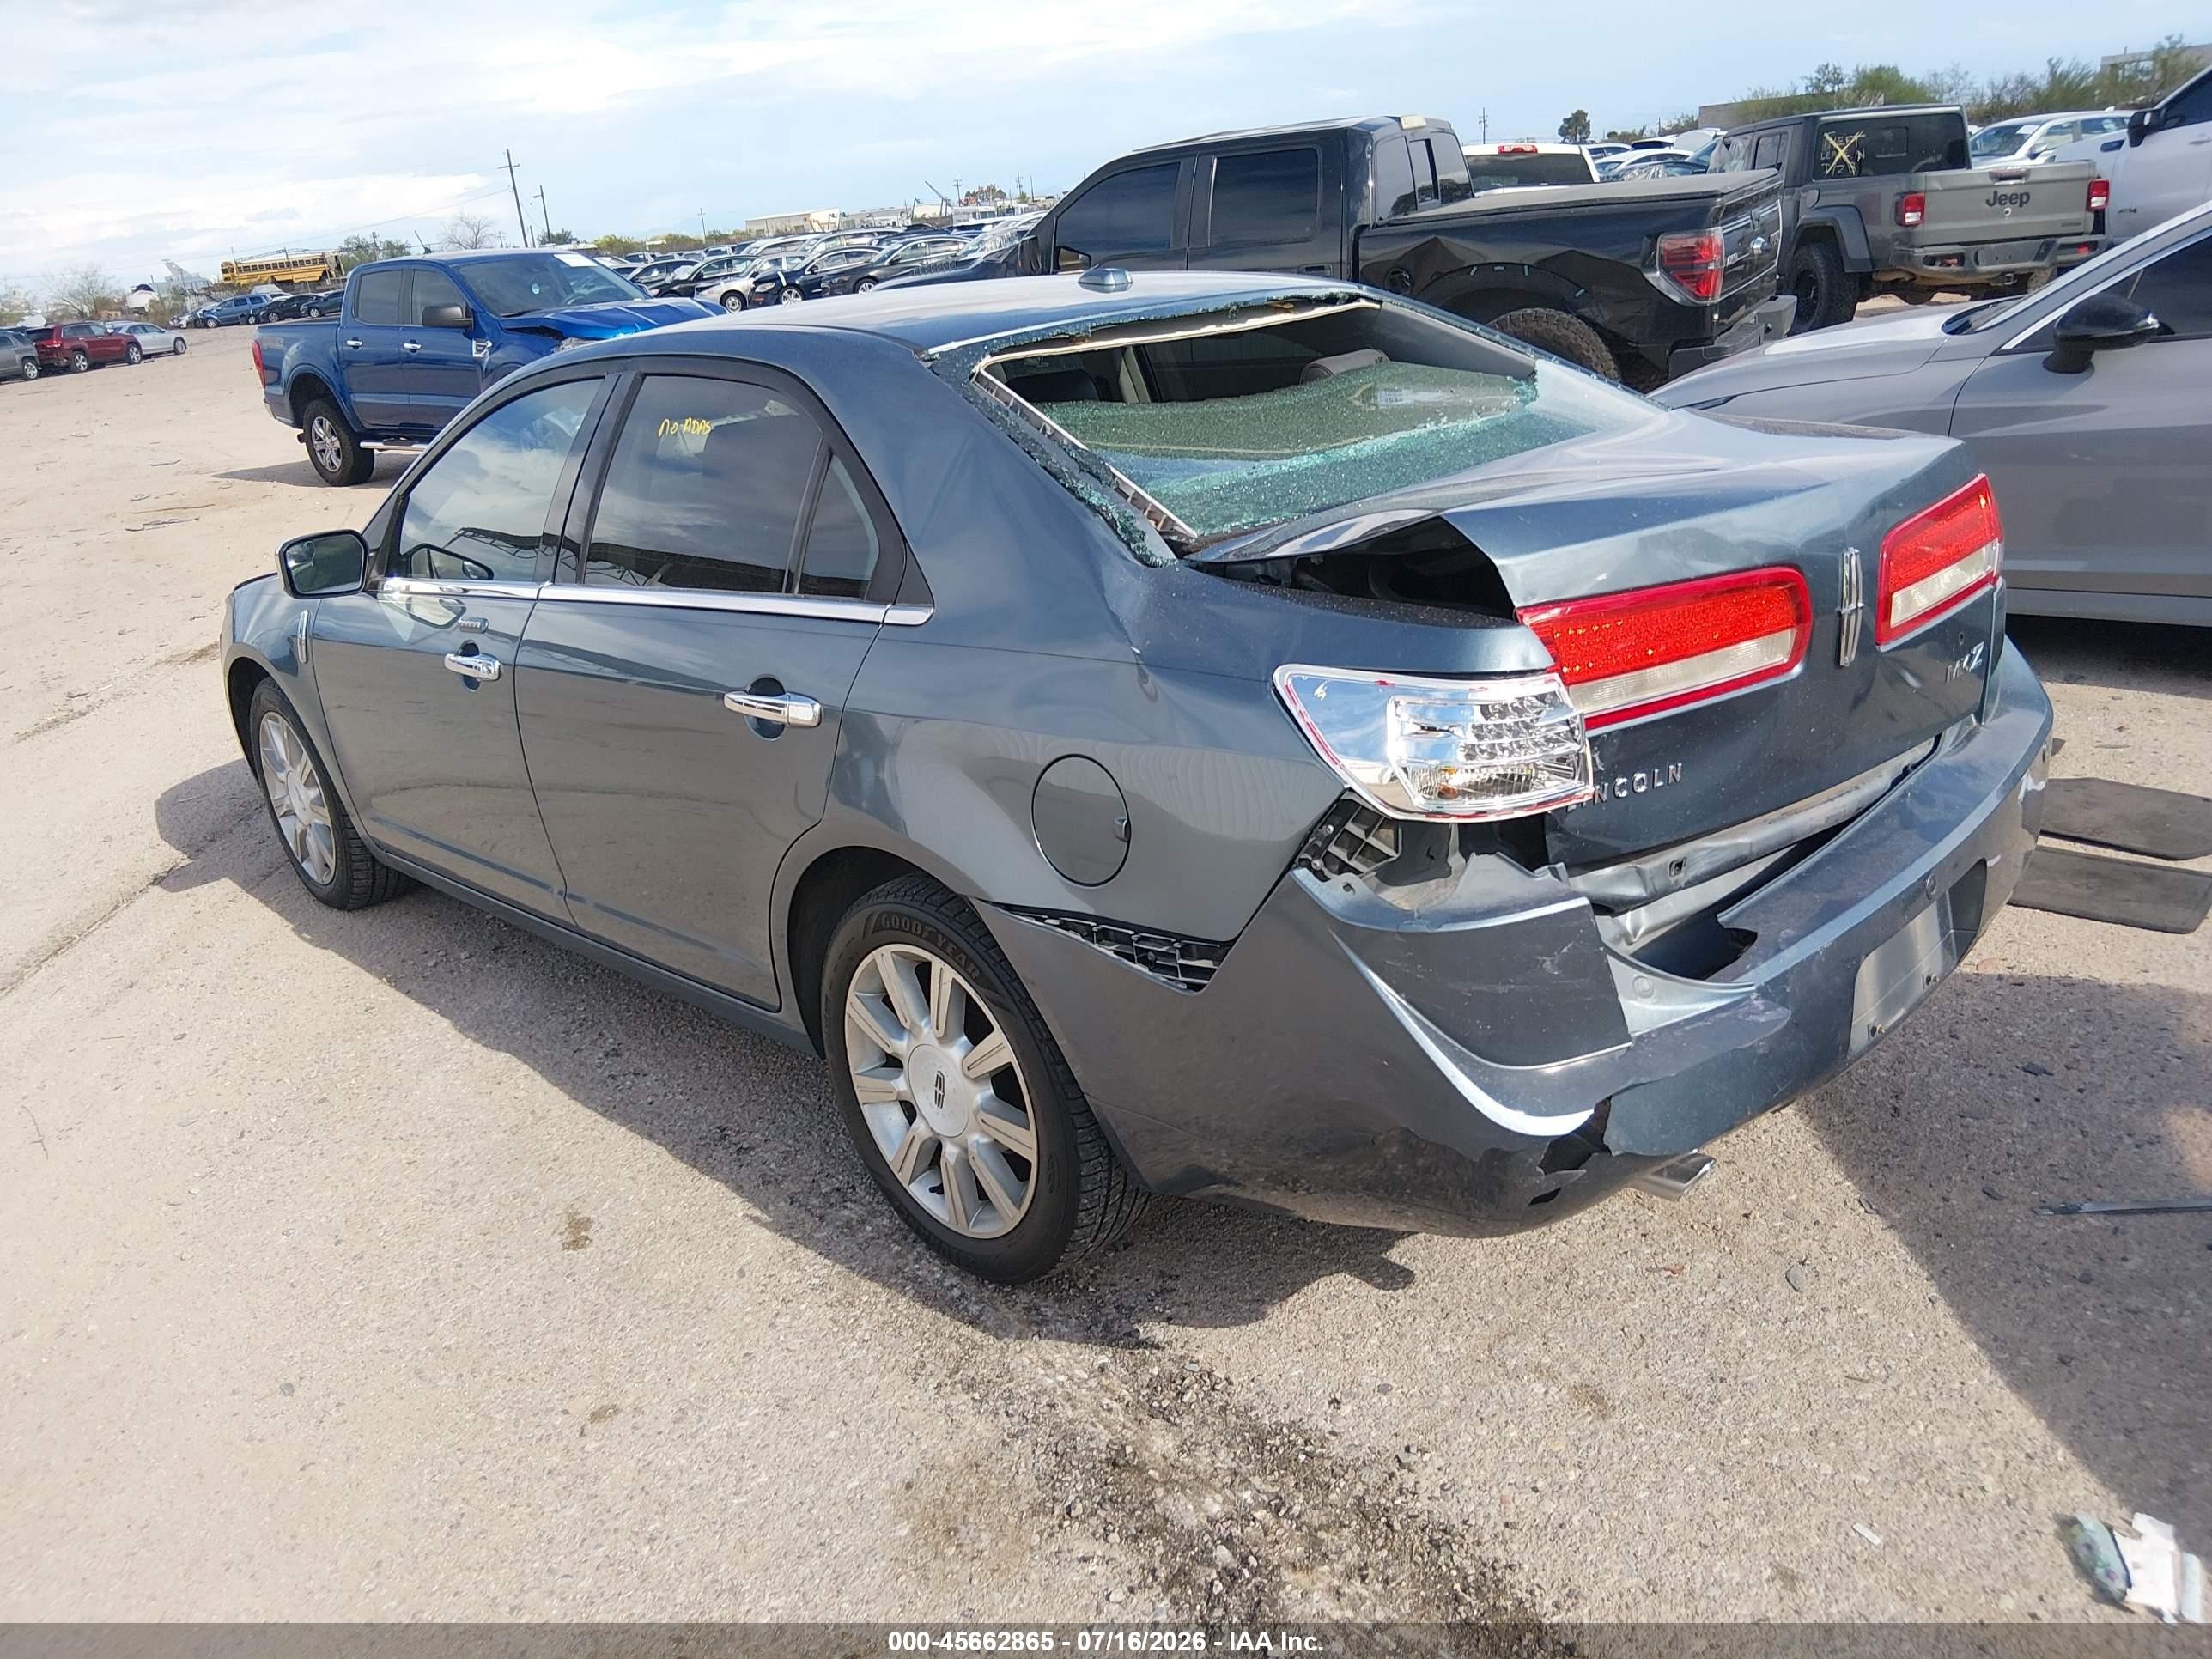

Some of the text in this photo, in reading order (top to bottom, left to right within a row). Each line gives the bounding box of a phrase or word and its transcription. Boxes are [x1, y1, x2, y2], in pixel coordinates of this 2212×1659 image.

[1985, 191, 2031, 208] Jeep
[1945, 641, 1983, 684] MKZ
[1567, 763, 1683, 813] NCOLN
